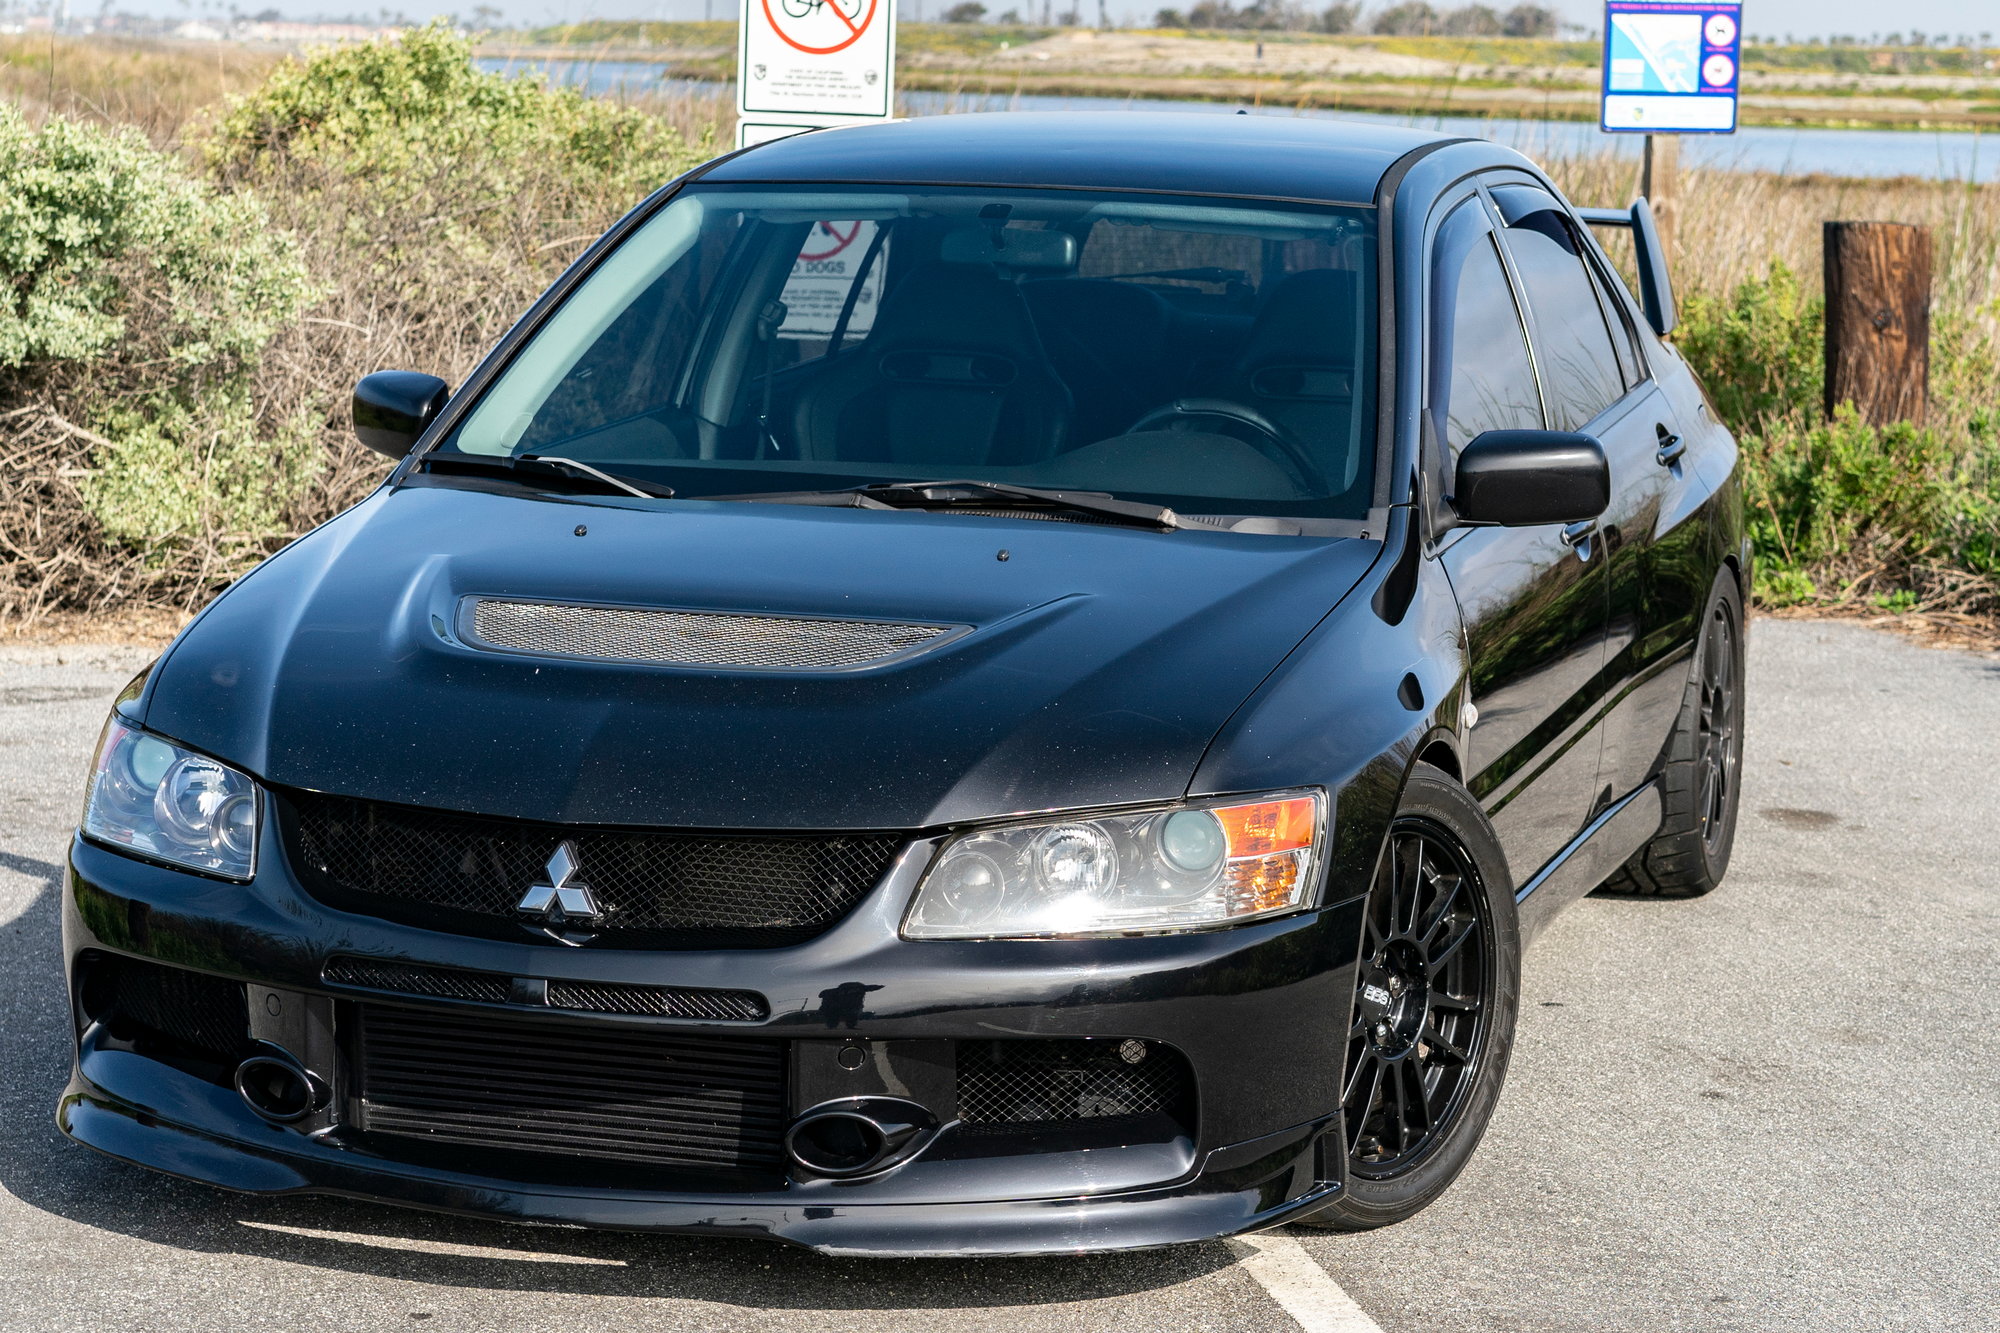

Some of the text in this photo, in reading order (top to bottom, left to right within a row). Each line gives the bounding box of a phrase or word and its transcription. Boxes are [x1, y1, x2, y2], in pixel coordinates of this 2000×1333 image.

[806, 261, 846, 274] DOGS
[1363, 984, 1390, 1006] BBS
[1472, 911, 1516, 1128] AZENIS
